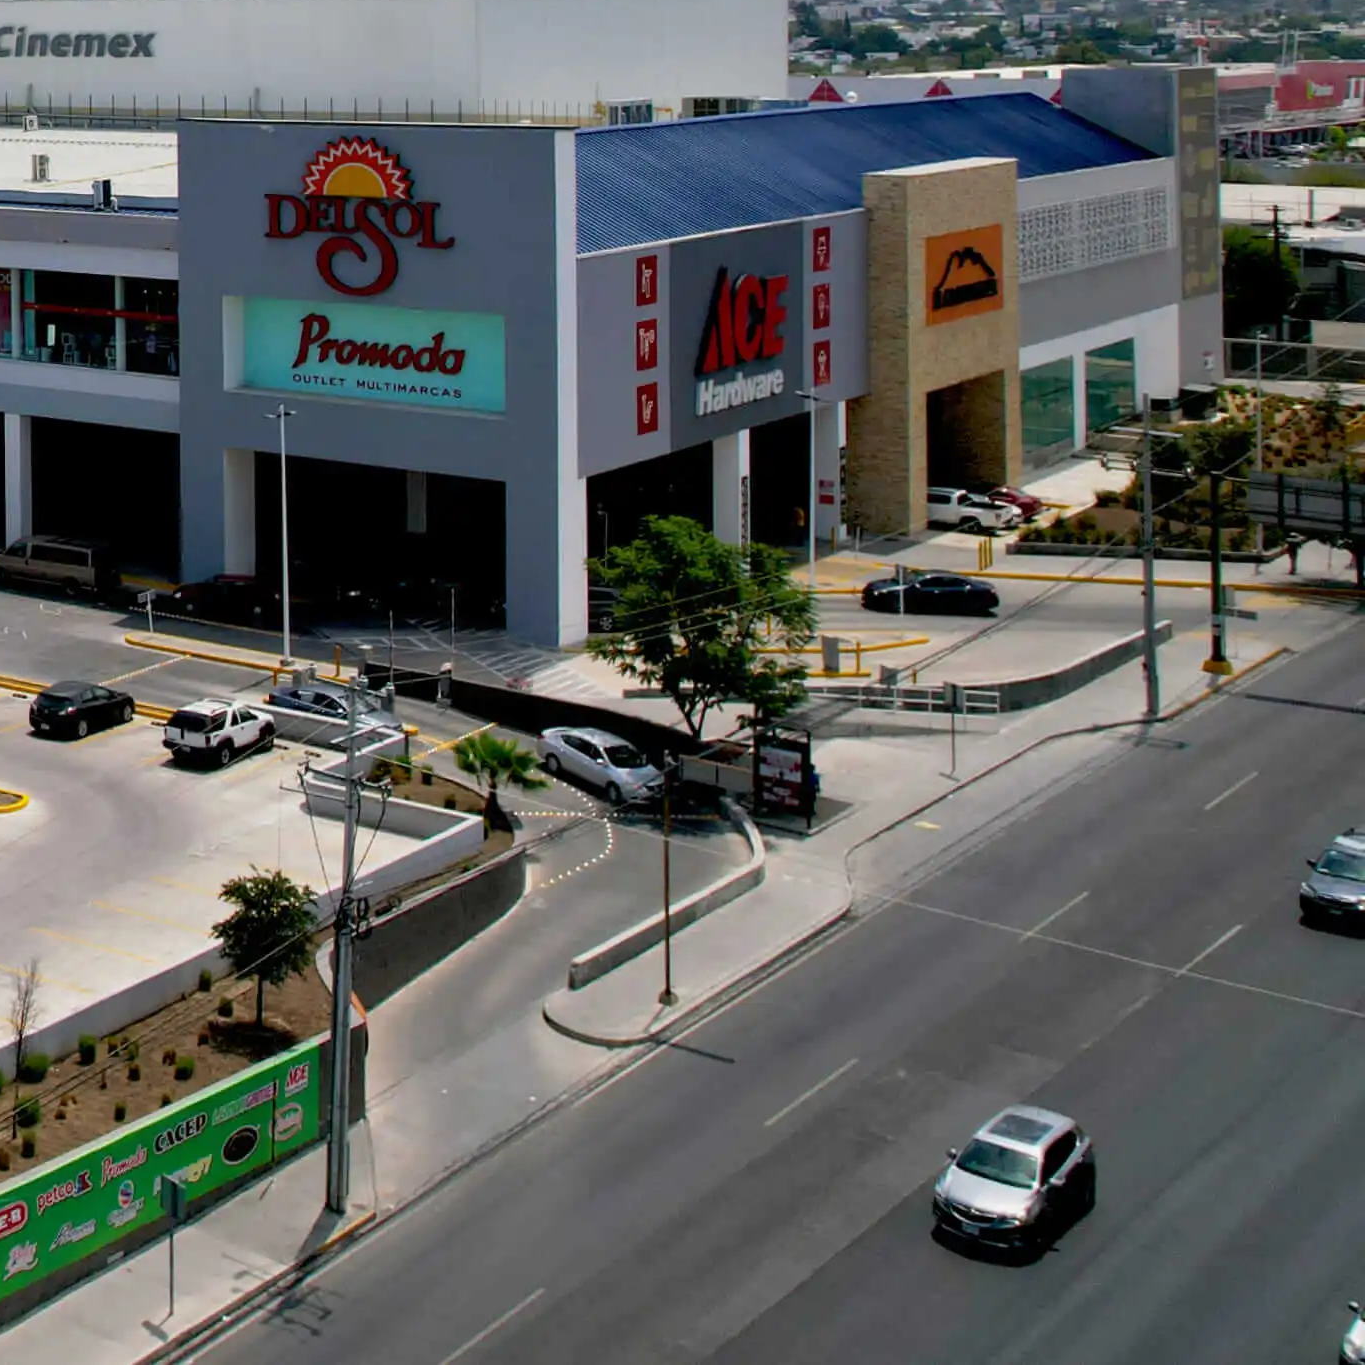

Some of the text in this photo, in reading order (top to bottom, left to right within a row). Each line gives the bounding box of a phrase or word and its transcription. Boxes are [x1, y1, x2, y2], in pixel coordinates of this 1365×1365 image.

[291, 312, 466, 376] Promoda
[696, 265, 789, 377] ACE
[292, 373, 462, 399] OUTLET MULTIMARCAS
[696, 369, 784, 417] Hardware
[37, 1180, 73, 1216] petco
